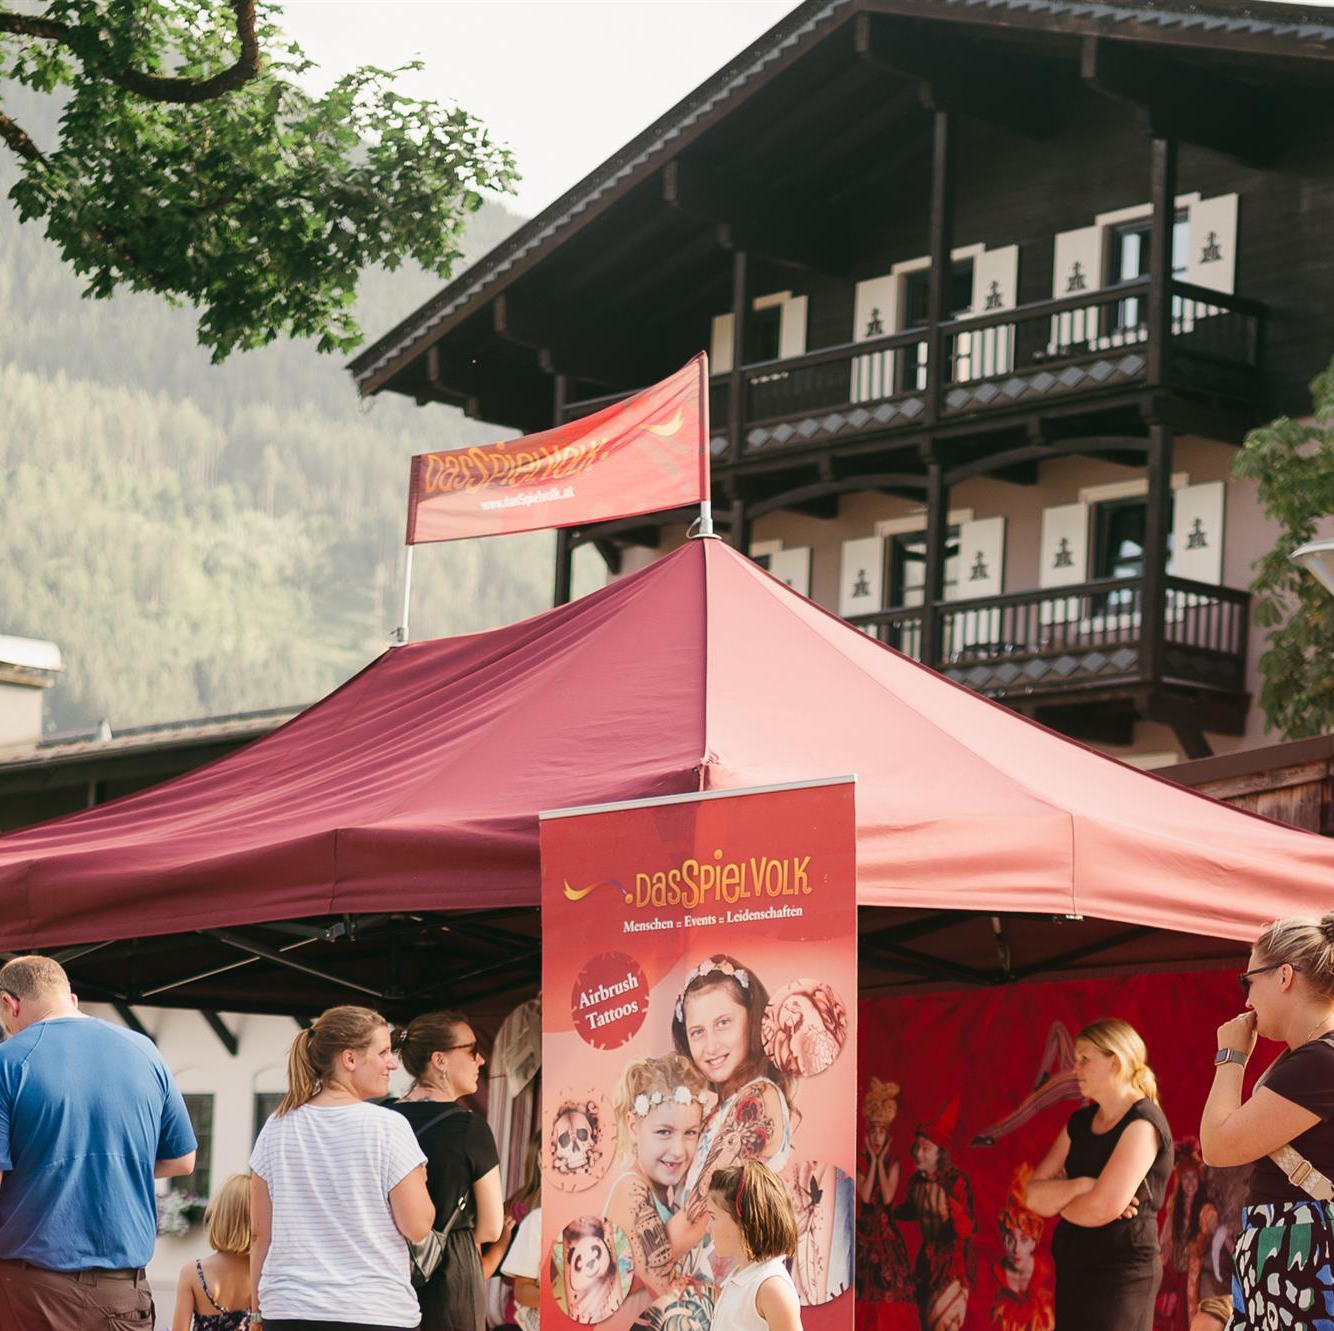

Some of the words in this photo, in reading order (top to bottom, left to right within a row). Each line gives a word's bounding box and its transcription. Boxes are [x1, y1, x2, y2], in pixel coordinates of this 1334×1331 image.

[623, 916, 674, 933] Menschen
[684, 915, 717, 929] Events
[726, 904, 803, 924] Leidenschaften
[578, 972, 639, 1010] Airbrush
[585, 1000, 639, 1031] Tattoos
